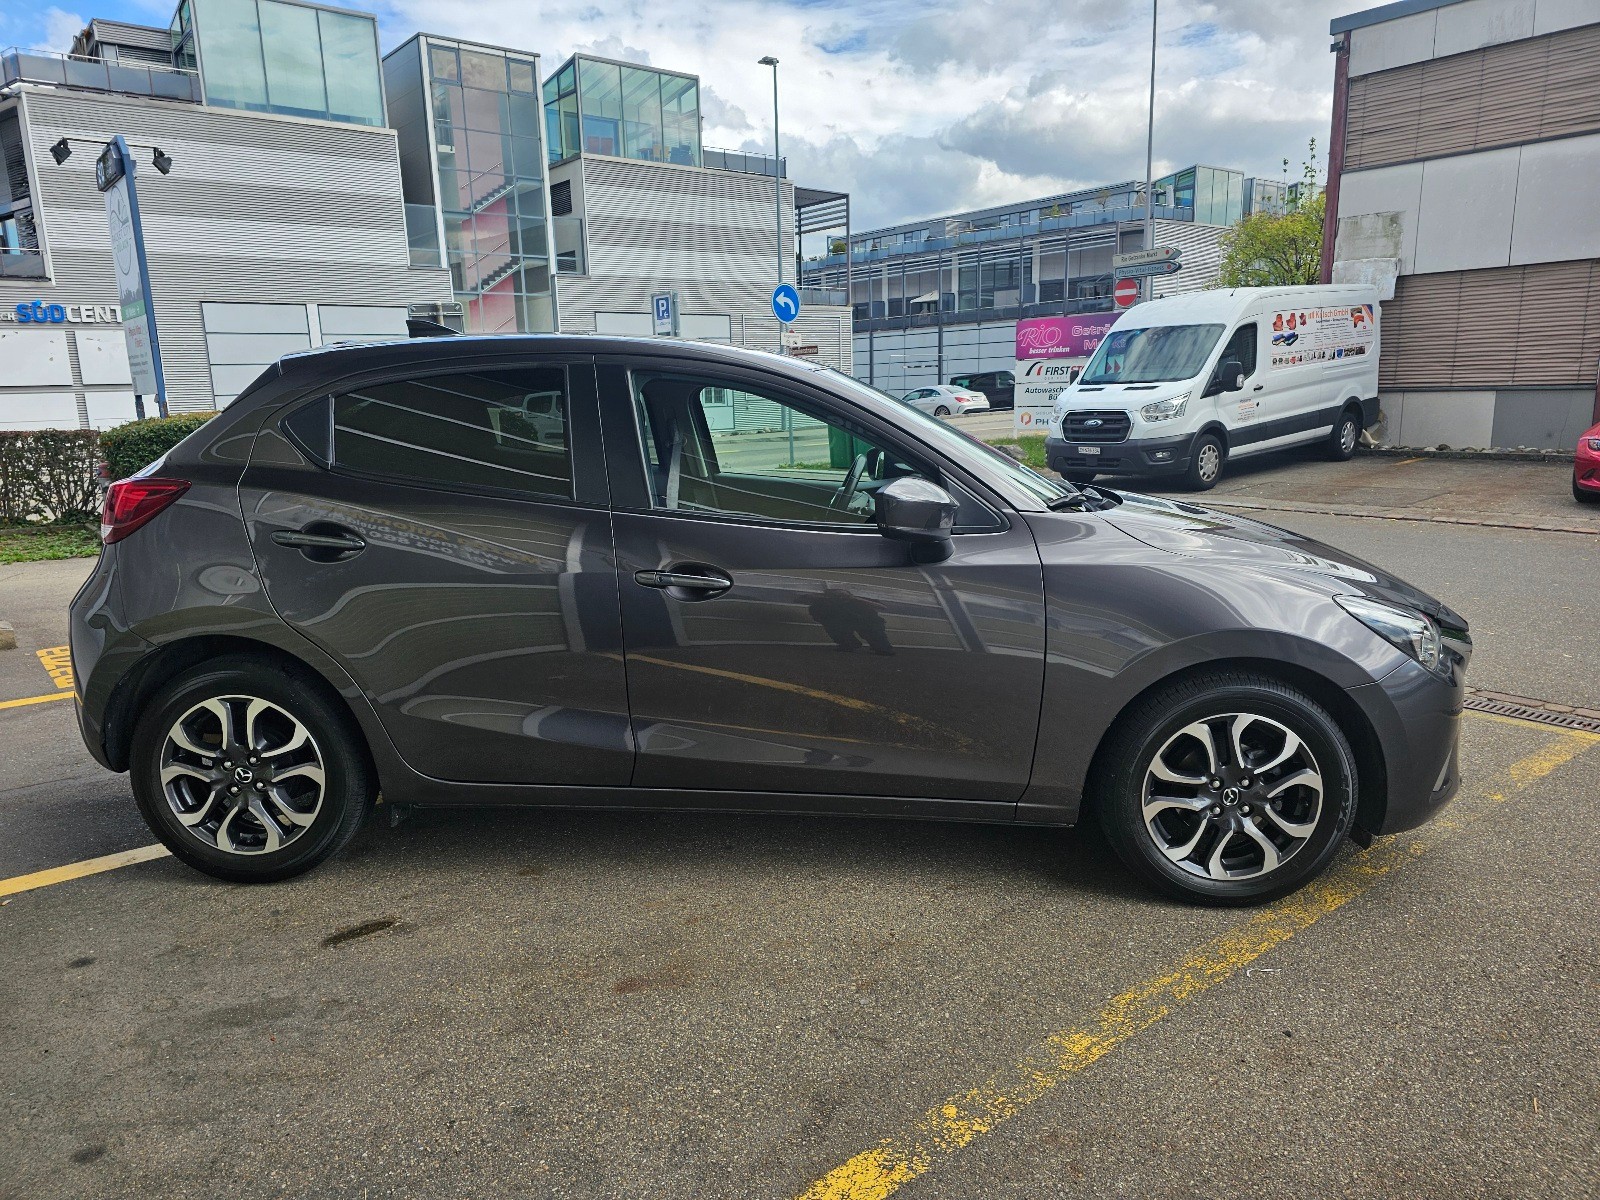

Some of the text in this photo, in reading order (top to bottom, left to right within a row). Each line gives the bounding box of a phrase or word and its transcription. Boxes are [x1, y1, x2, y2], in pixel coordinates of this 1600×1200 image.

[658, 299, 667, 317] P
[1334, 308, 1349, 317] GmbH
[1029, 347, 1048, 355] besser
